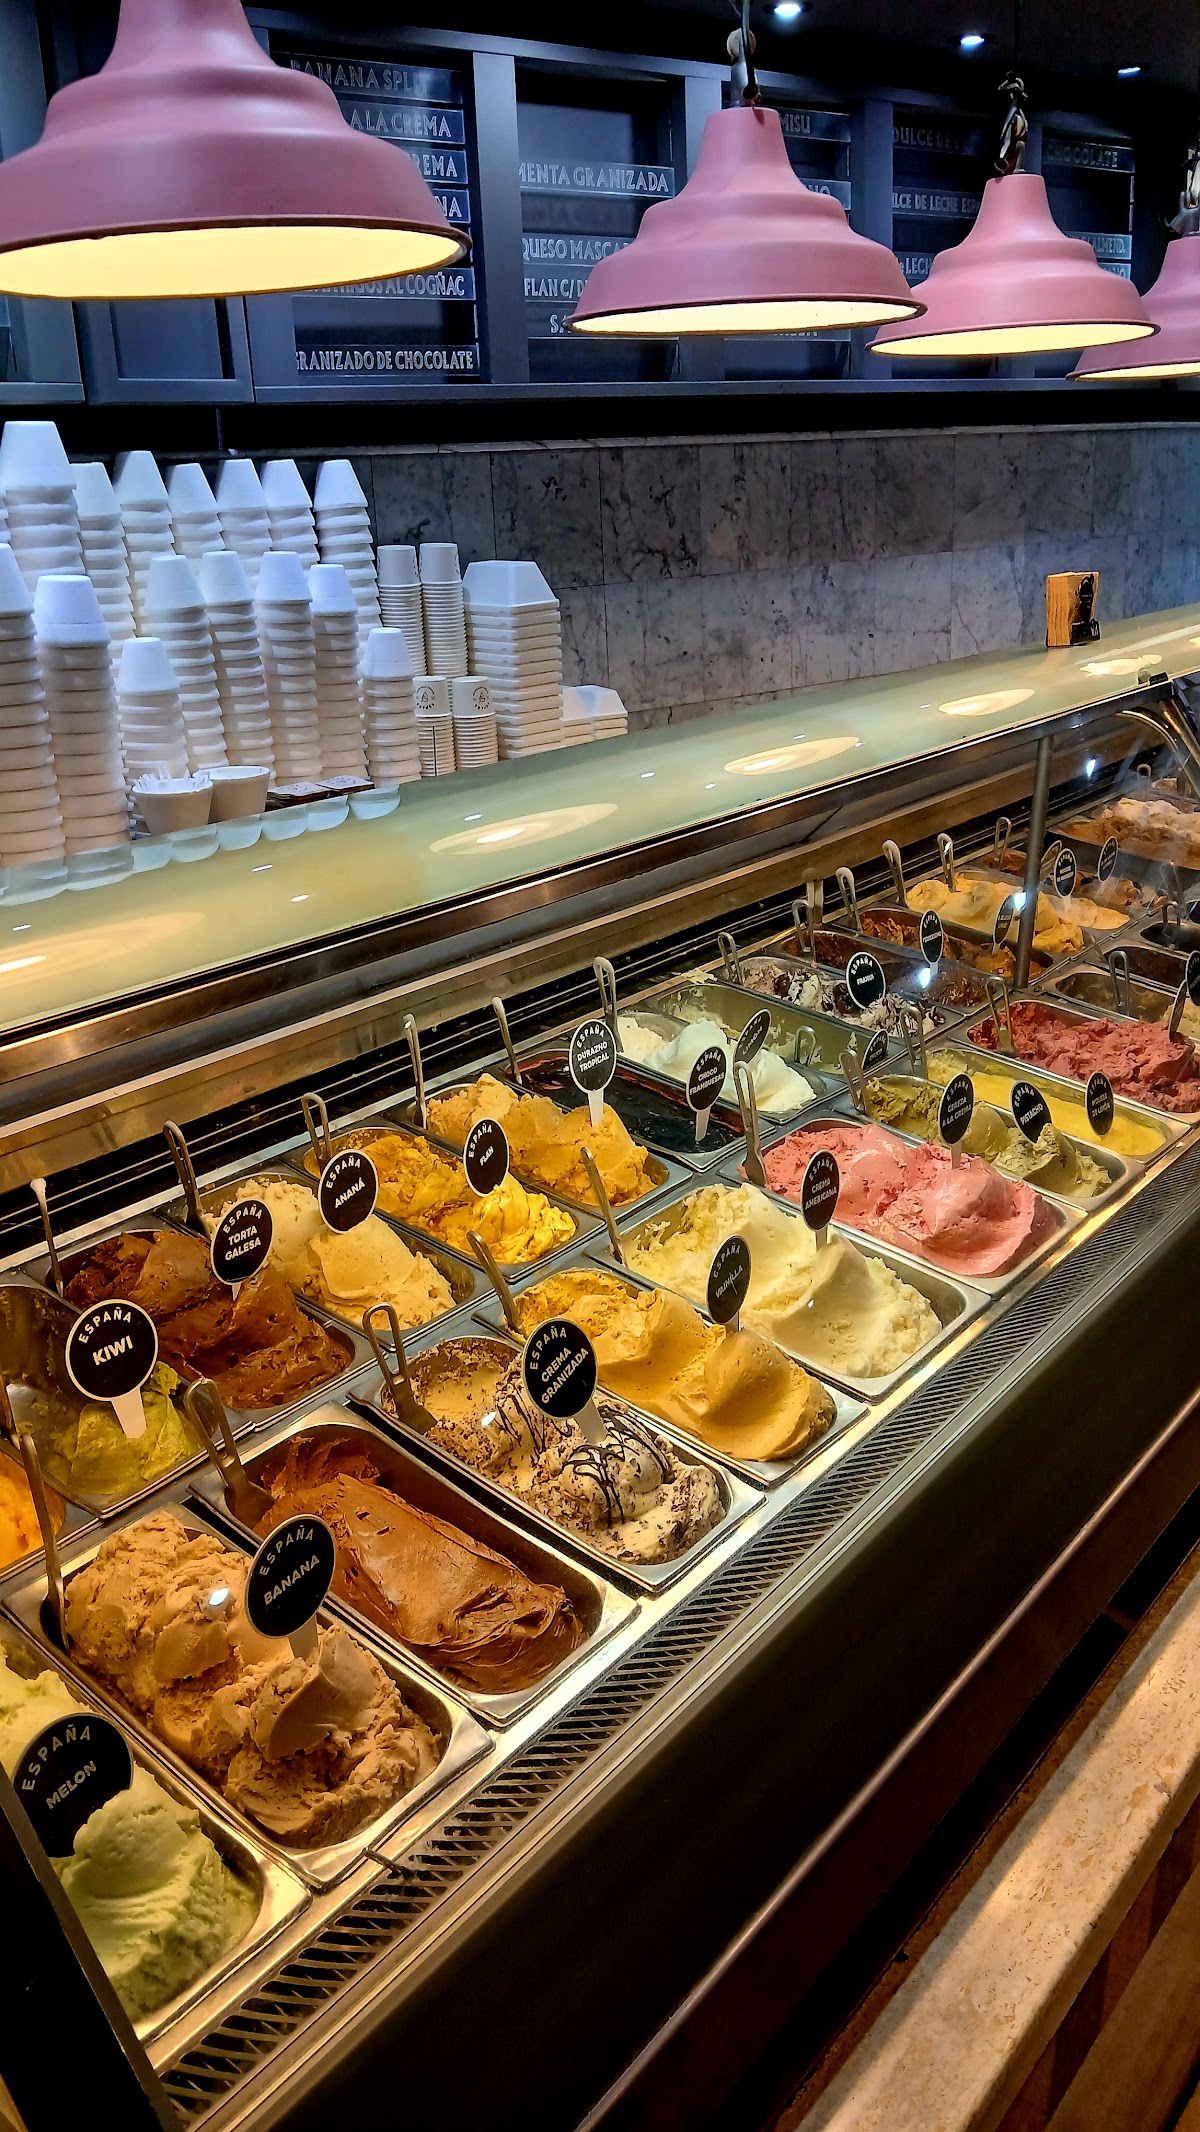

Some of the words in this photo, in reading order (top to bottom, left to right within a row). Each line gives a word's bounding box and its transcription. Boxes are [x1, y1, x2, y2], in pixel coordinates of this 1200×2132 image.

[383, 69, 429, 94] SPLIT
[351, 109, 363, 130] A
[366, 110, 389, 132] LA
[391, 112, 452, 137] CREMA
[1047, 144, 1118, 168] CHOCOLATE
[573, 166, 670, 193] GRANIZADA
[915, 193, 927, 211] DE
[930, 195, 959, 213] LECHE
[524, 277, 558, 297] FLAN
[376, 350, 393, 370] DE
[395, 350, 474, 370] CHOCOLATE
[851, 955, 873, 975] ESPAÑA
[577, 1024, 605, 1049] ESPAÑA
[577, 1041, 608, 1062] DURAZNO
[580, 1052, 610, 1073] TROPICAL
[696, 1049, 722, 1072] ESPAÑA
[698, 1066, 718, 1082] CHOCO
[946, 1079, 969, 1102] ESPAÑA
[1014, 1083, 1035, 1108] ESPAÑA
[947, 1114, 955, 1125] LA
[1020, 1102, 1044, 1126] PISTACHO
[468, 1122, 493, 1159] ESPAÑA
[479, 1145, 494, 1167] FLAN
[326, 1154, 361, 1189] ESPAÑA
[808, 1156, 834, 1182] ESPAÑA
[811, 1177, 831, 1194] CREMA
[804, 1186, 838, 1211] AMERICANA
[222, 1203, 263, 1234] ESPAÑA
[228, 1225, 258, 1246] TORTA
[224, 1236, 262, 1261] GALESA
[713, 1241, 741, 1279] ESPAÑA
[78, 1306, 132, 1344] ESPAÑA
[92, 1334, 134, 1366] KIWI
[529, 1325, 568, 1371] ESPAÑA
[541, 1347, 572, 1383] CREMA
[541, 1347, 589, 1404] GRANIZADA
[258, 1524, 314, 1576] ESPAÑA
[263, 1554, 320, 1606] BANANA
[21, 1723, 91, 1791] ESPAÑA
[45, 1760, 97, 1810] MELON
